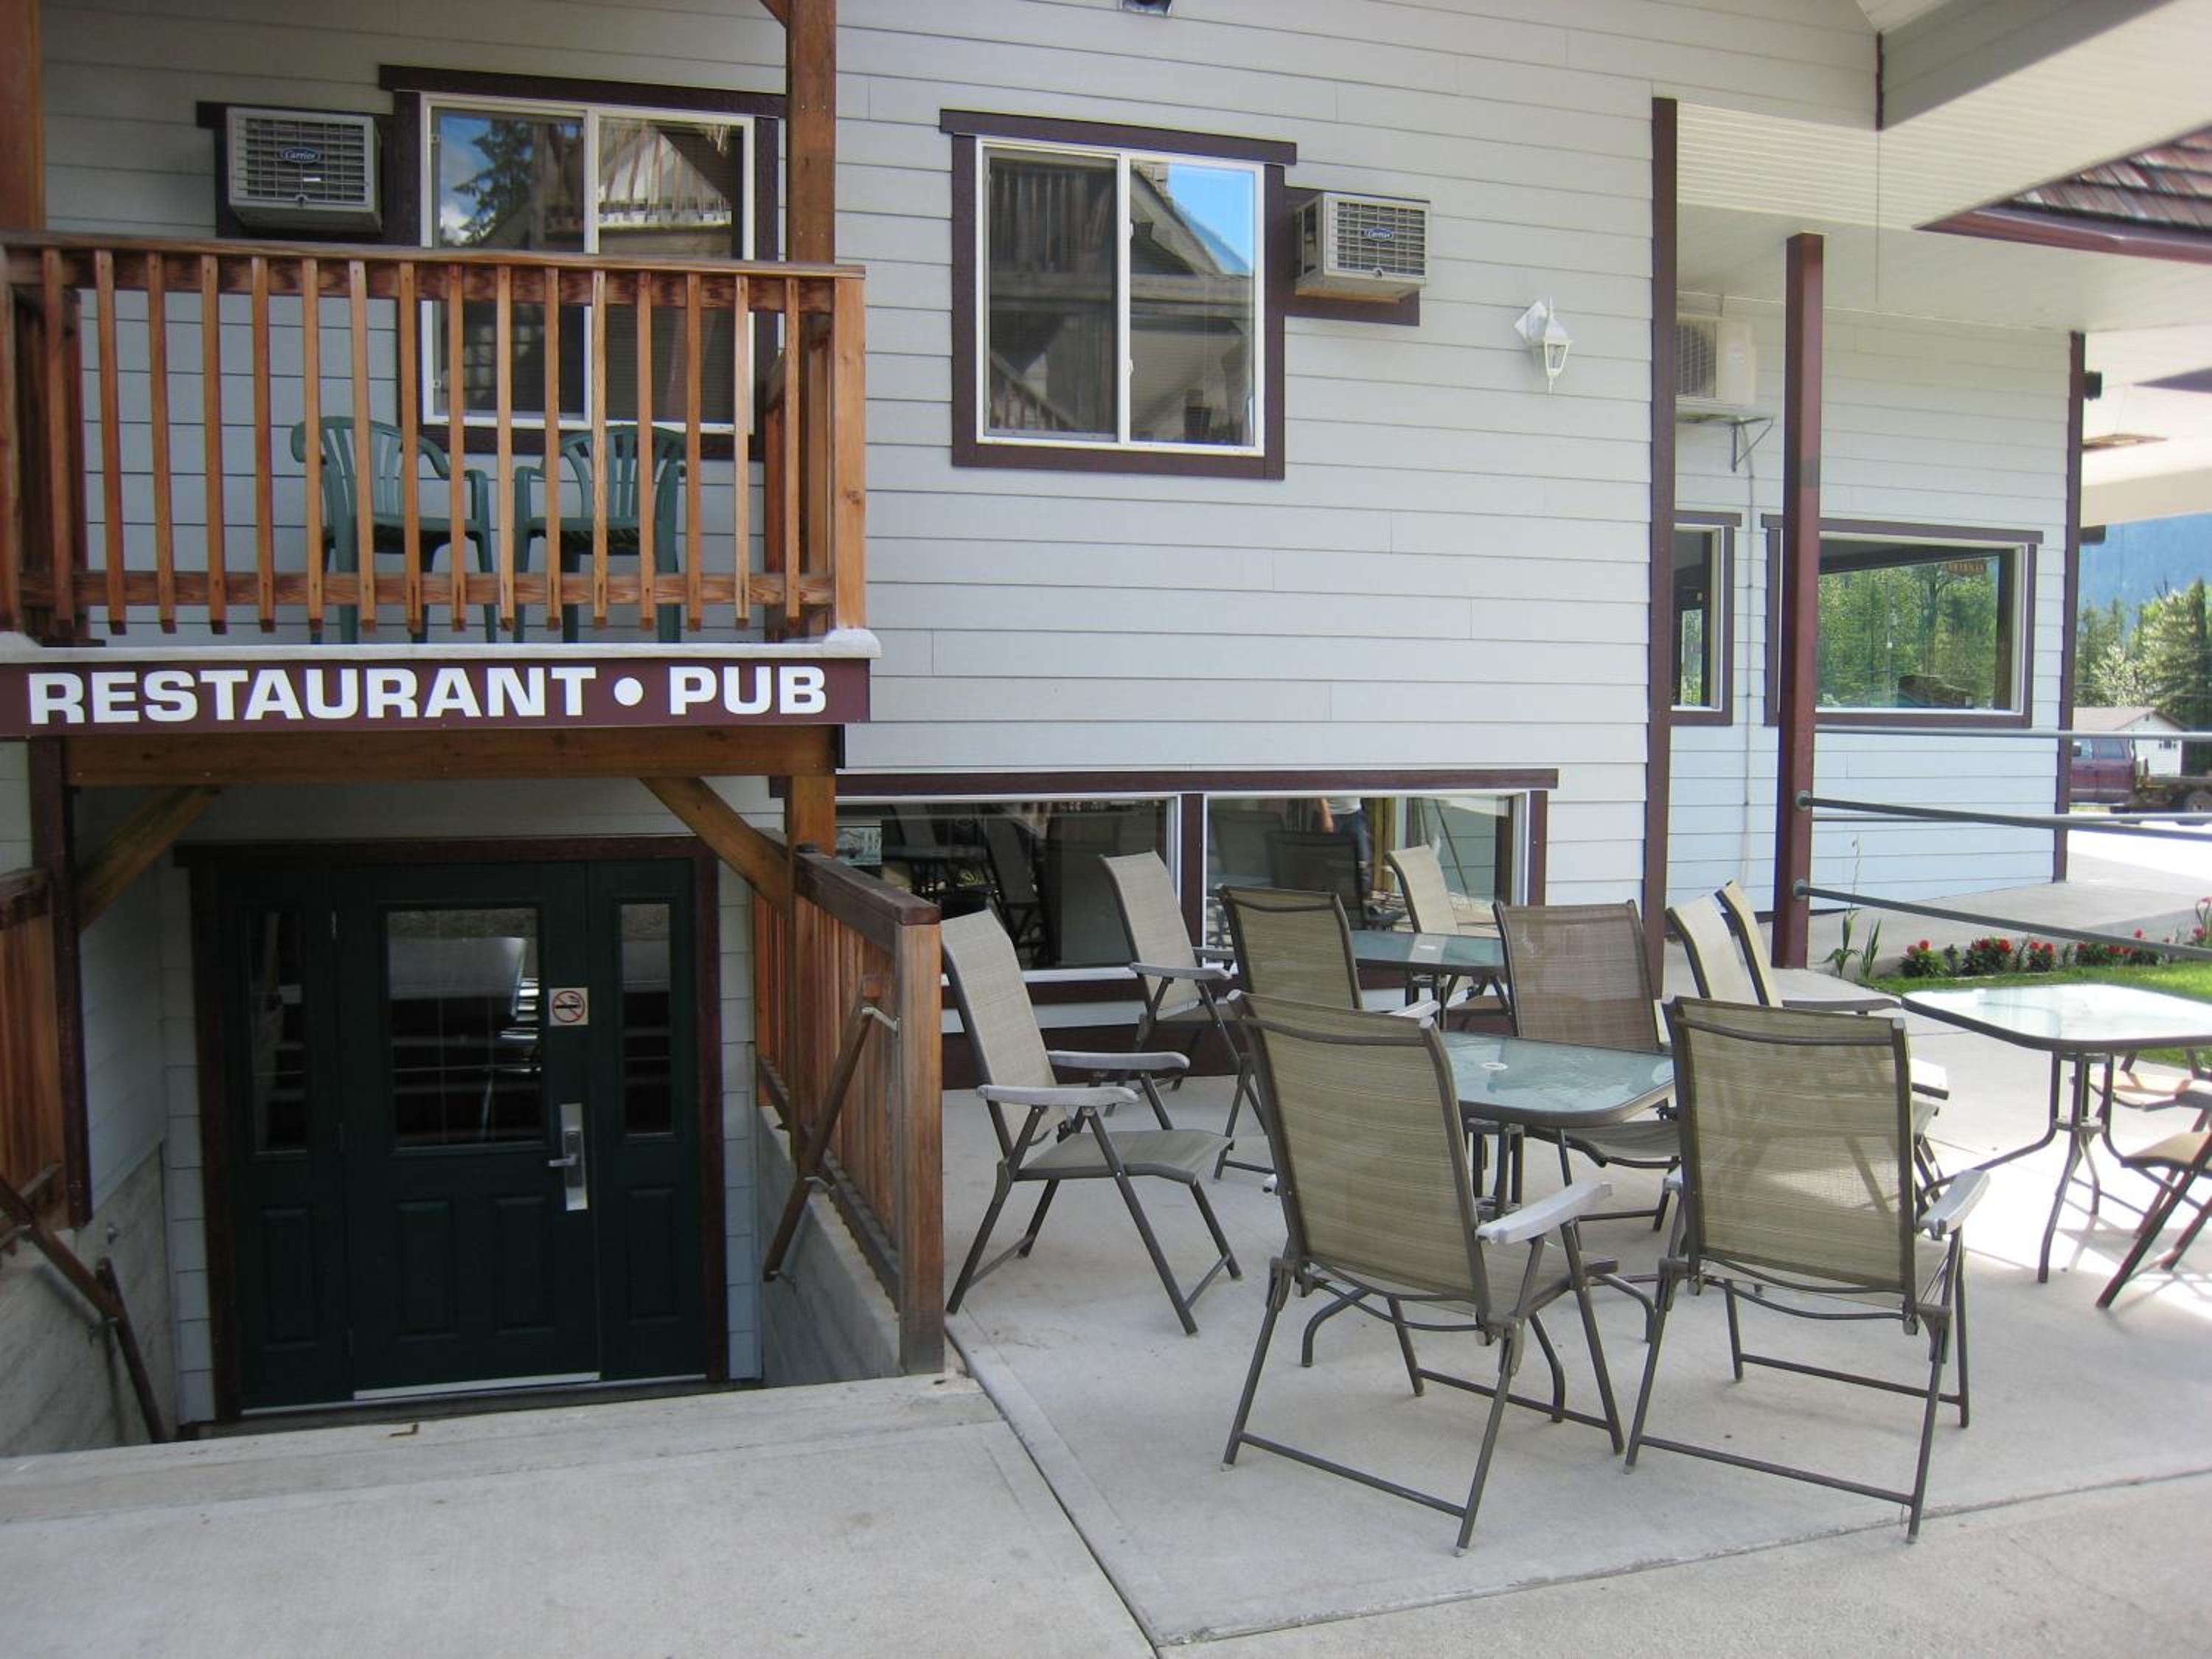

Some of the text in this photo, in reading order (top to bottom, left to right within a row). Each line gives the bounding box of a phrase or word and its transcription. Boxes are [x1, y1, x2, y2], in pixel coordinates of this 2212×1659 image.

[285, 150, 316, 161] Carrier
[28, 666, 827, 725] RESTAURANT PUB
